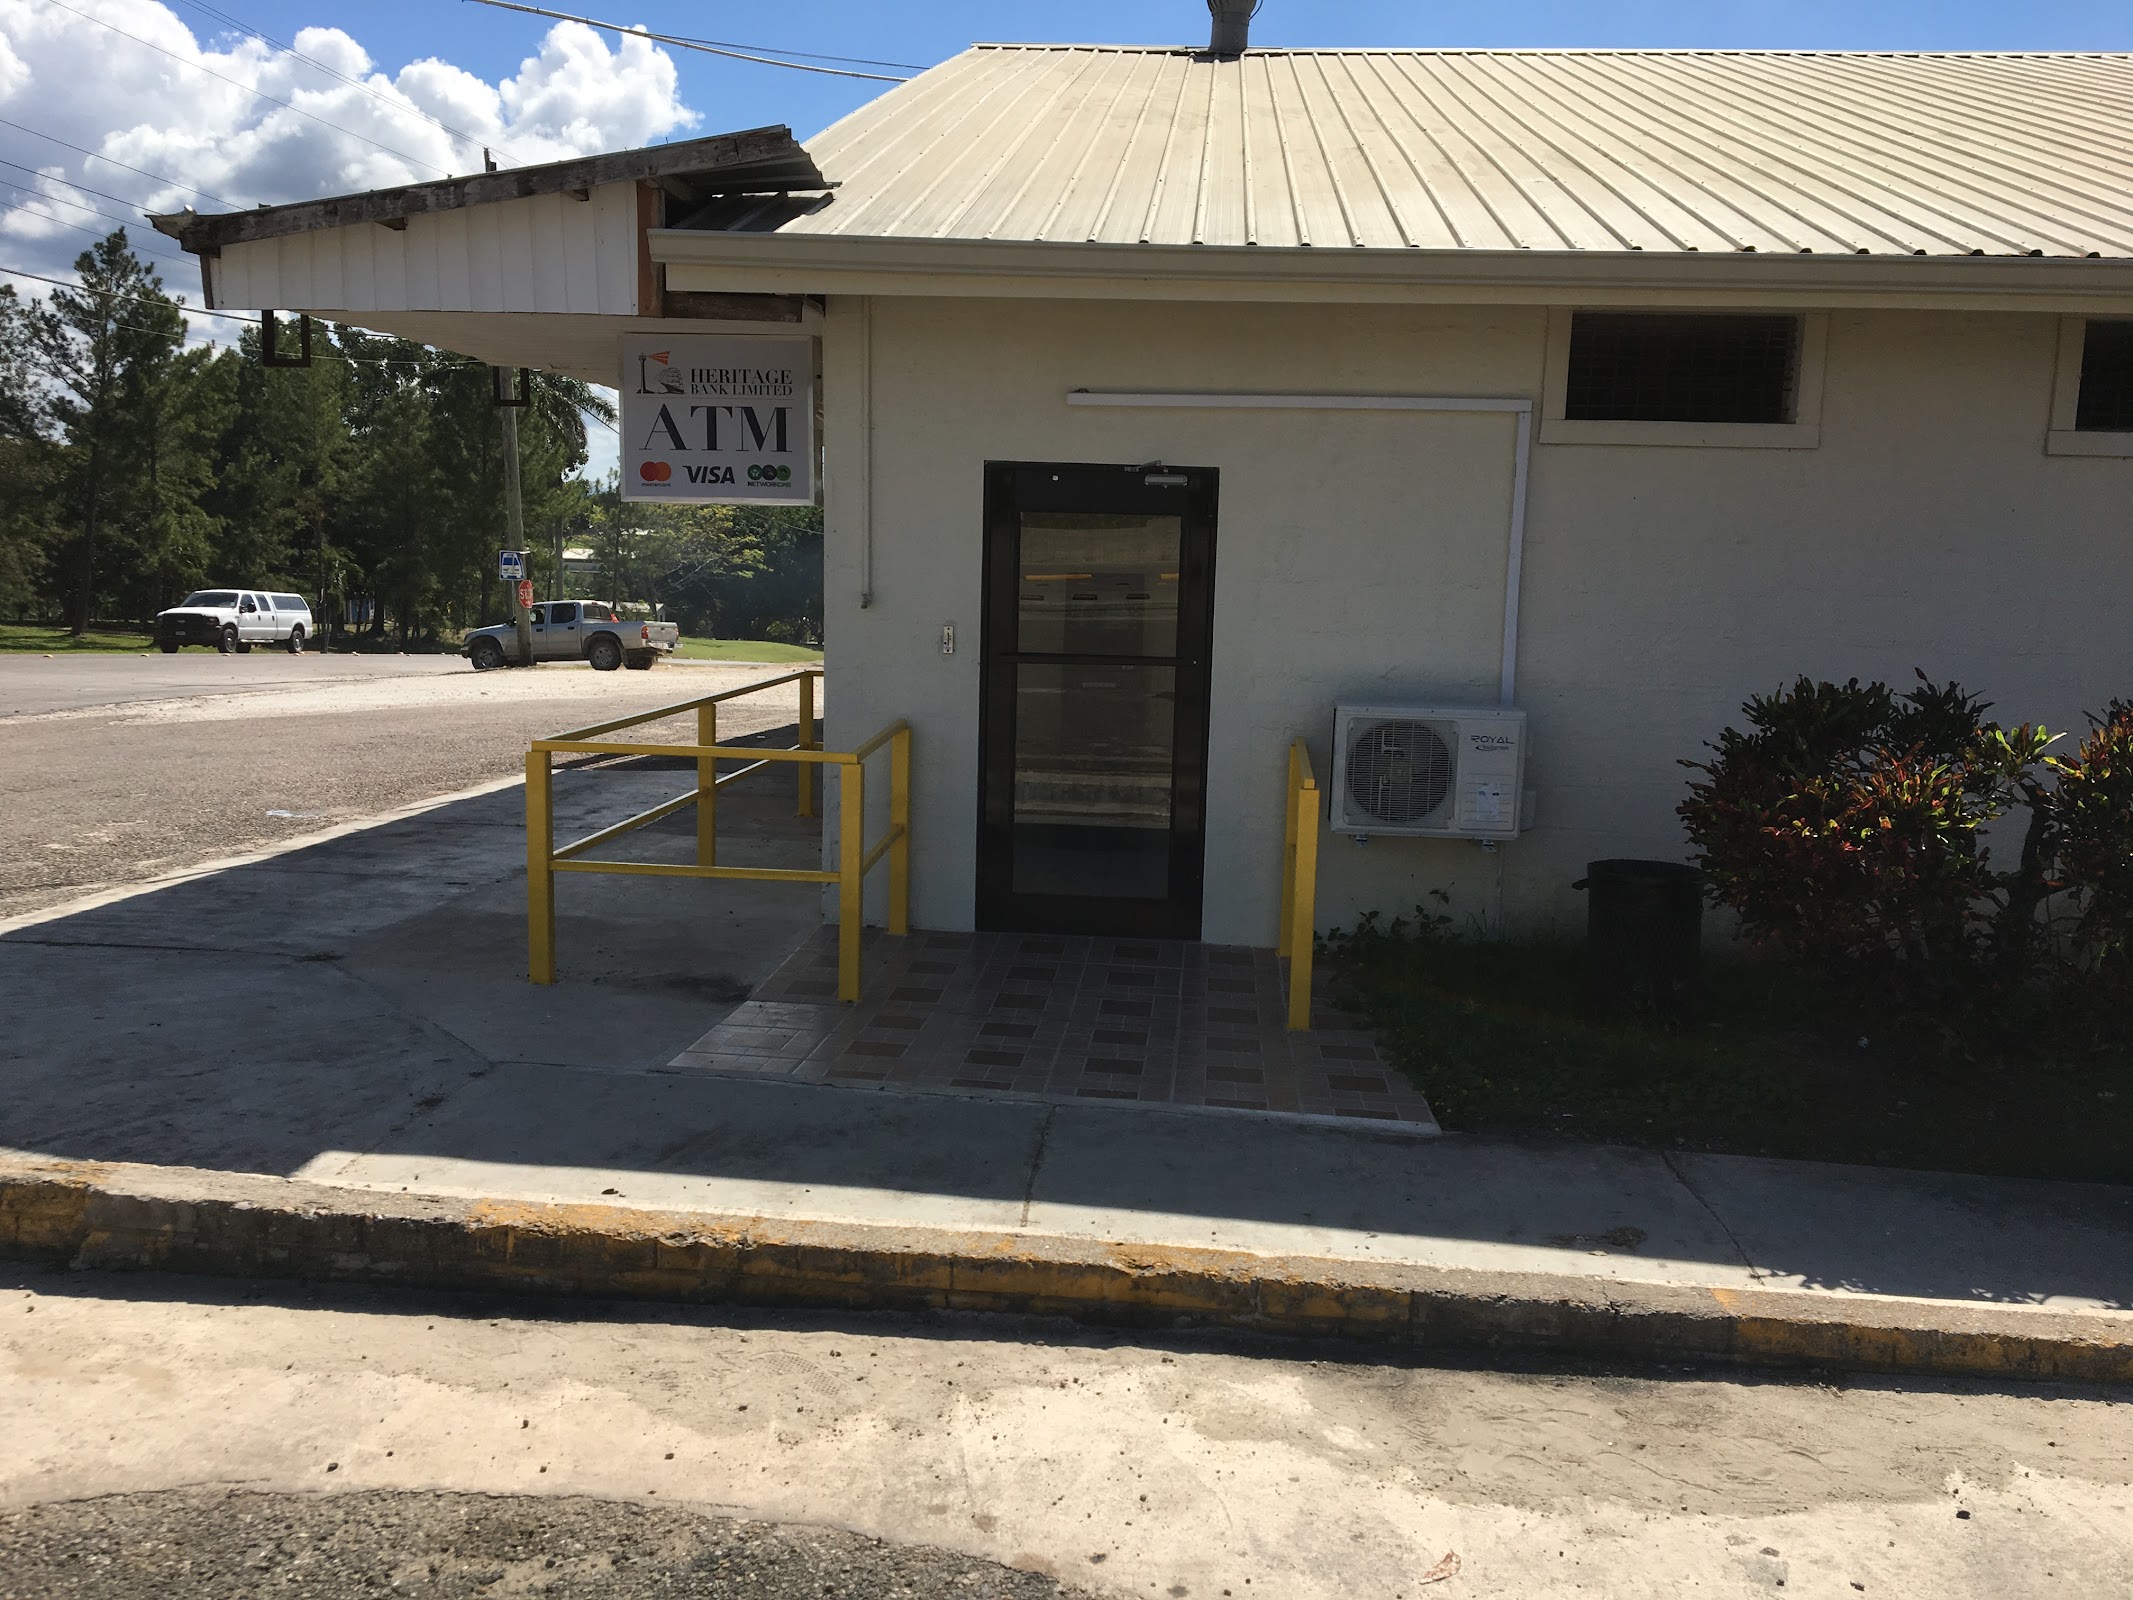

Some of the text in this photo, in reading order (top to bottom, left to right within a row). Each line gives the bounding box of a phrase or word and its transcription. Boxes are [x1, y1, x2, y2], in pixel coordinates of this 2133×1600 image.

[690, 368, 793, 385] HERITAGE
[691, 384, 793, 396] BANK LIMITED
[639, 403, 793, 453] ATM
[682, 465, 736, 485] VISA
[1470, 735, 1515, 744] ROYAL
